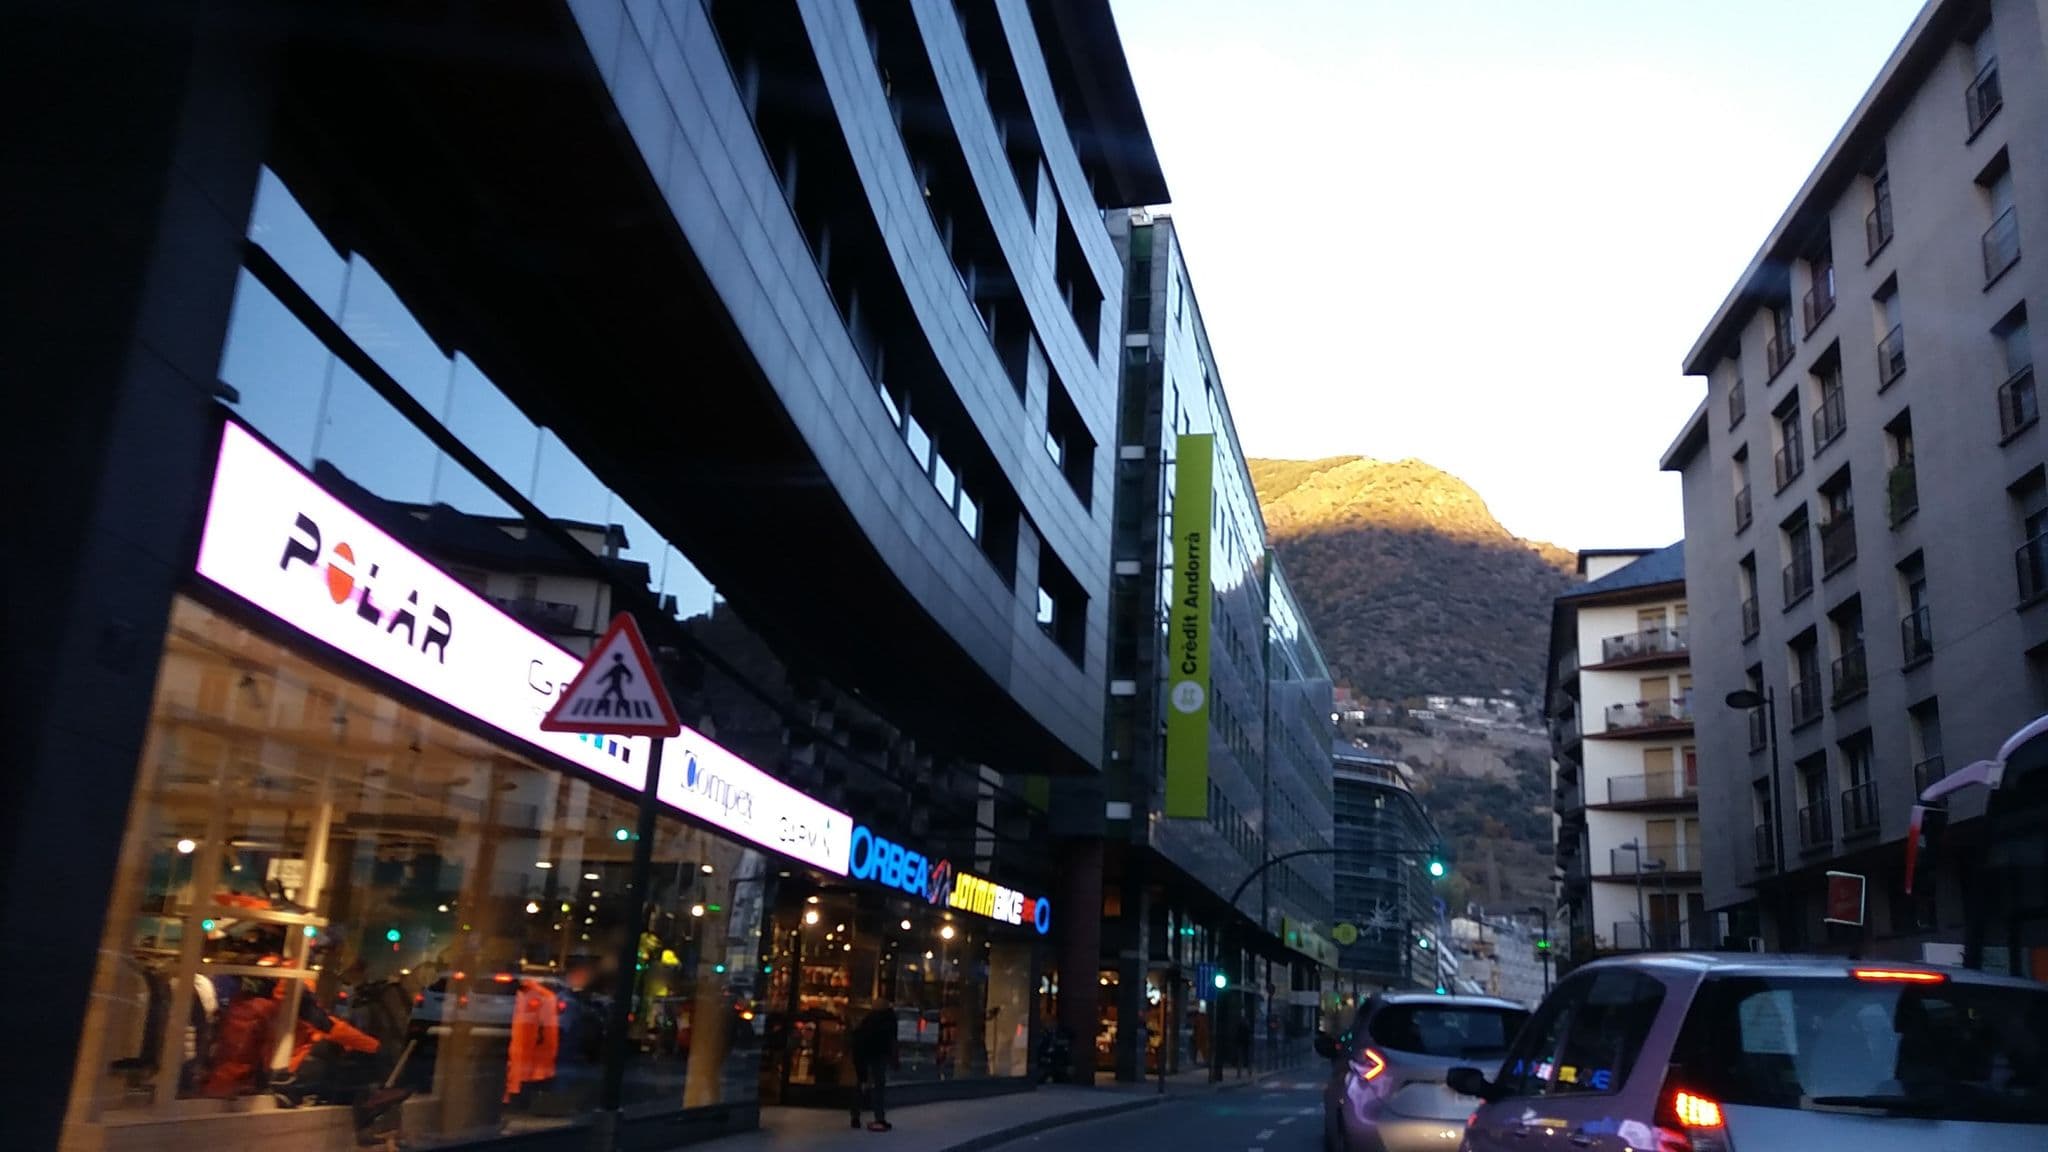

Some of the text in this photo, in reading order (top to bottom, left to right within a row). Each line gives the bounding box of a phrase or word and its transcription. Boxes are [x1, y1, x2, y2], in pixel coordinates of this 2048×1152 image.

[279, 511, 452, 665] POLAR
[1181, 532, 1201, 675] Crèdit Andorrà
[850, 825, 928, 898] ORBEA
